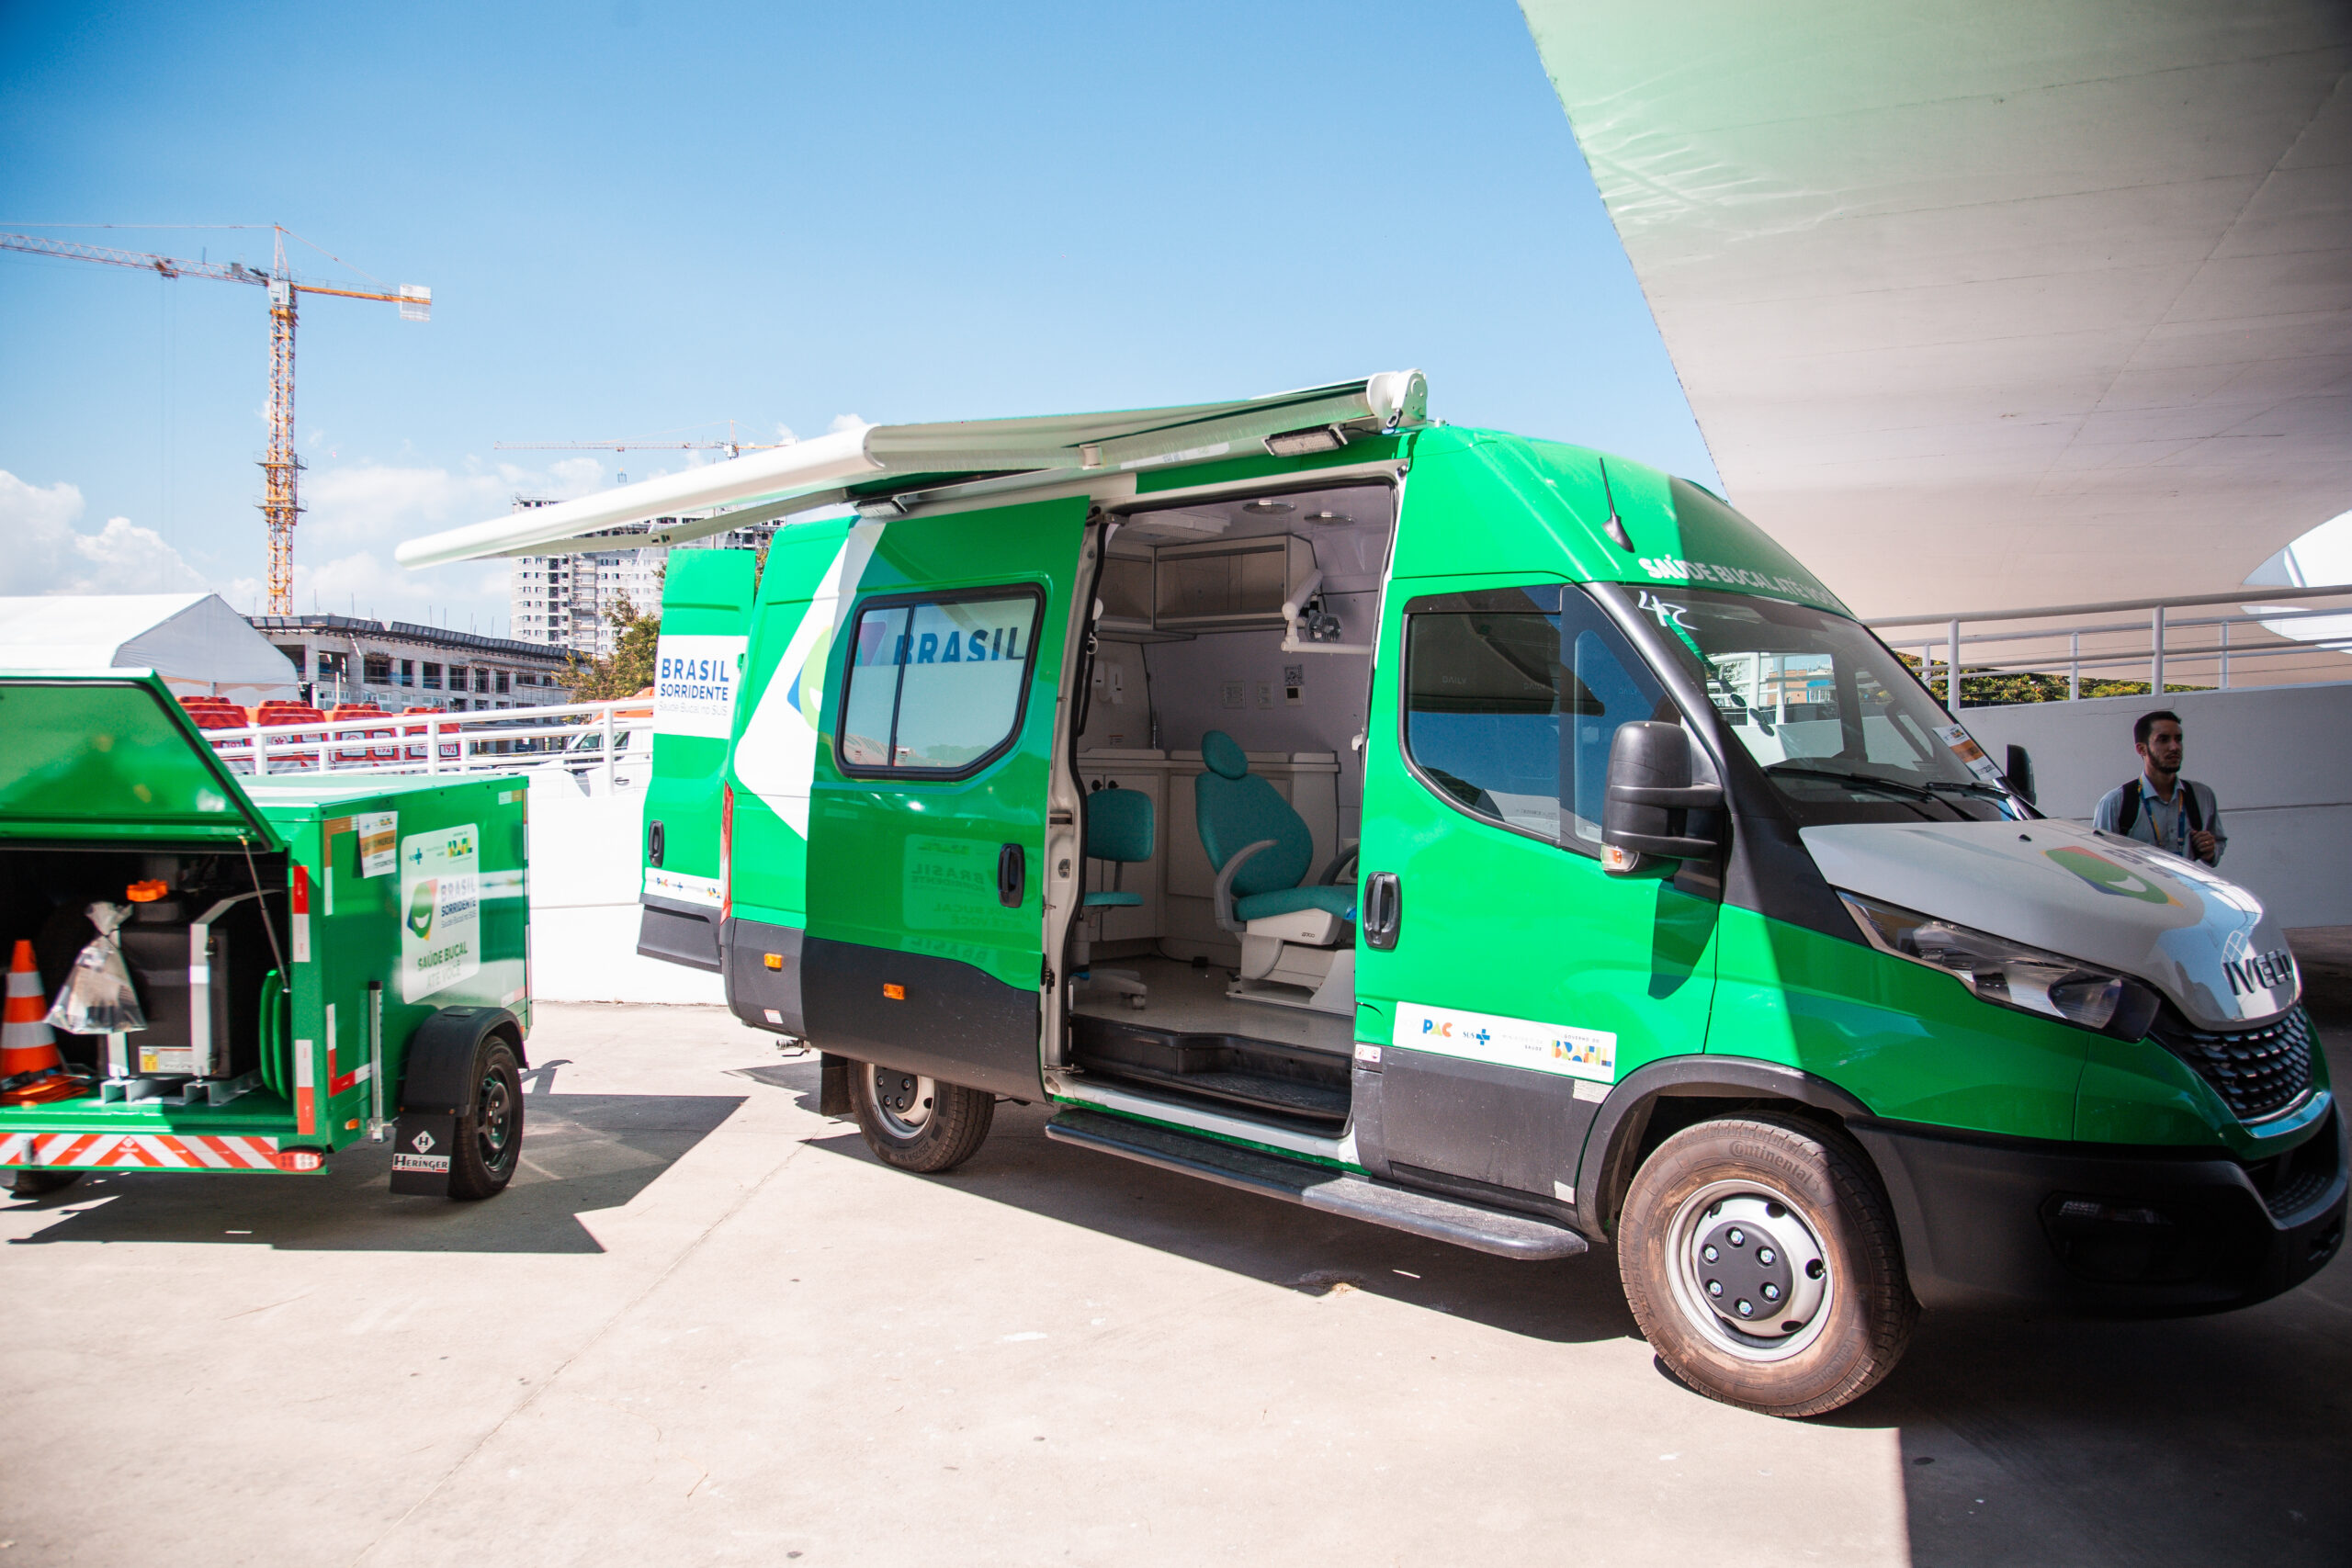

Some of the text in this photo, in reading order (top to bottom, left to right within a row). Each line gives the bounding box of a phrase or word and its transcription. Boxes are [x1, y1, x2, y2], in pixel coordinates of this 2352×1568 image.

[1638, 554, 1719, 581] SAÚDE
[1714, 565, 1781, 592] BUCAL
[1775, 576, 1806, 598] ATÉ
[893, 627, 1024, 665] BRASIL
[662, 659, 729, 682] BRASIL
[661, 683, 729, 701] SORRIDENTE
[443, 743, 456, 754] 192
[441, 876, 476, 902] BRASIL
[441, 897, 477, 917] SORRIDENTE
[417, 941, 469, 972] SAÚDE BUCAL
[1422, 1019, 1453, 1038] PAC
[1463, 1031, 1476, 1039] SUS
[1551, 1039, 1612, 1067] BRASIL
[418, 1136, 429, 1146] H
[1728, 1140, 1814, 1184] Continental
